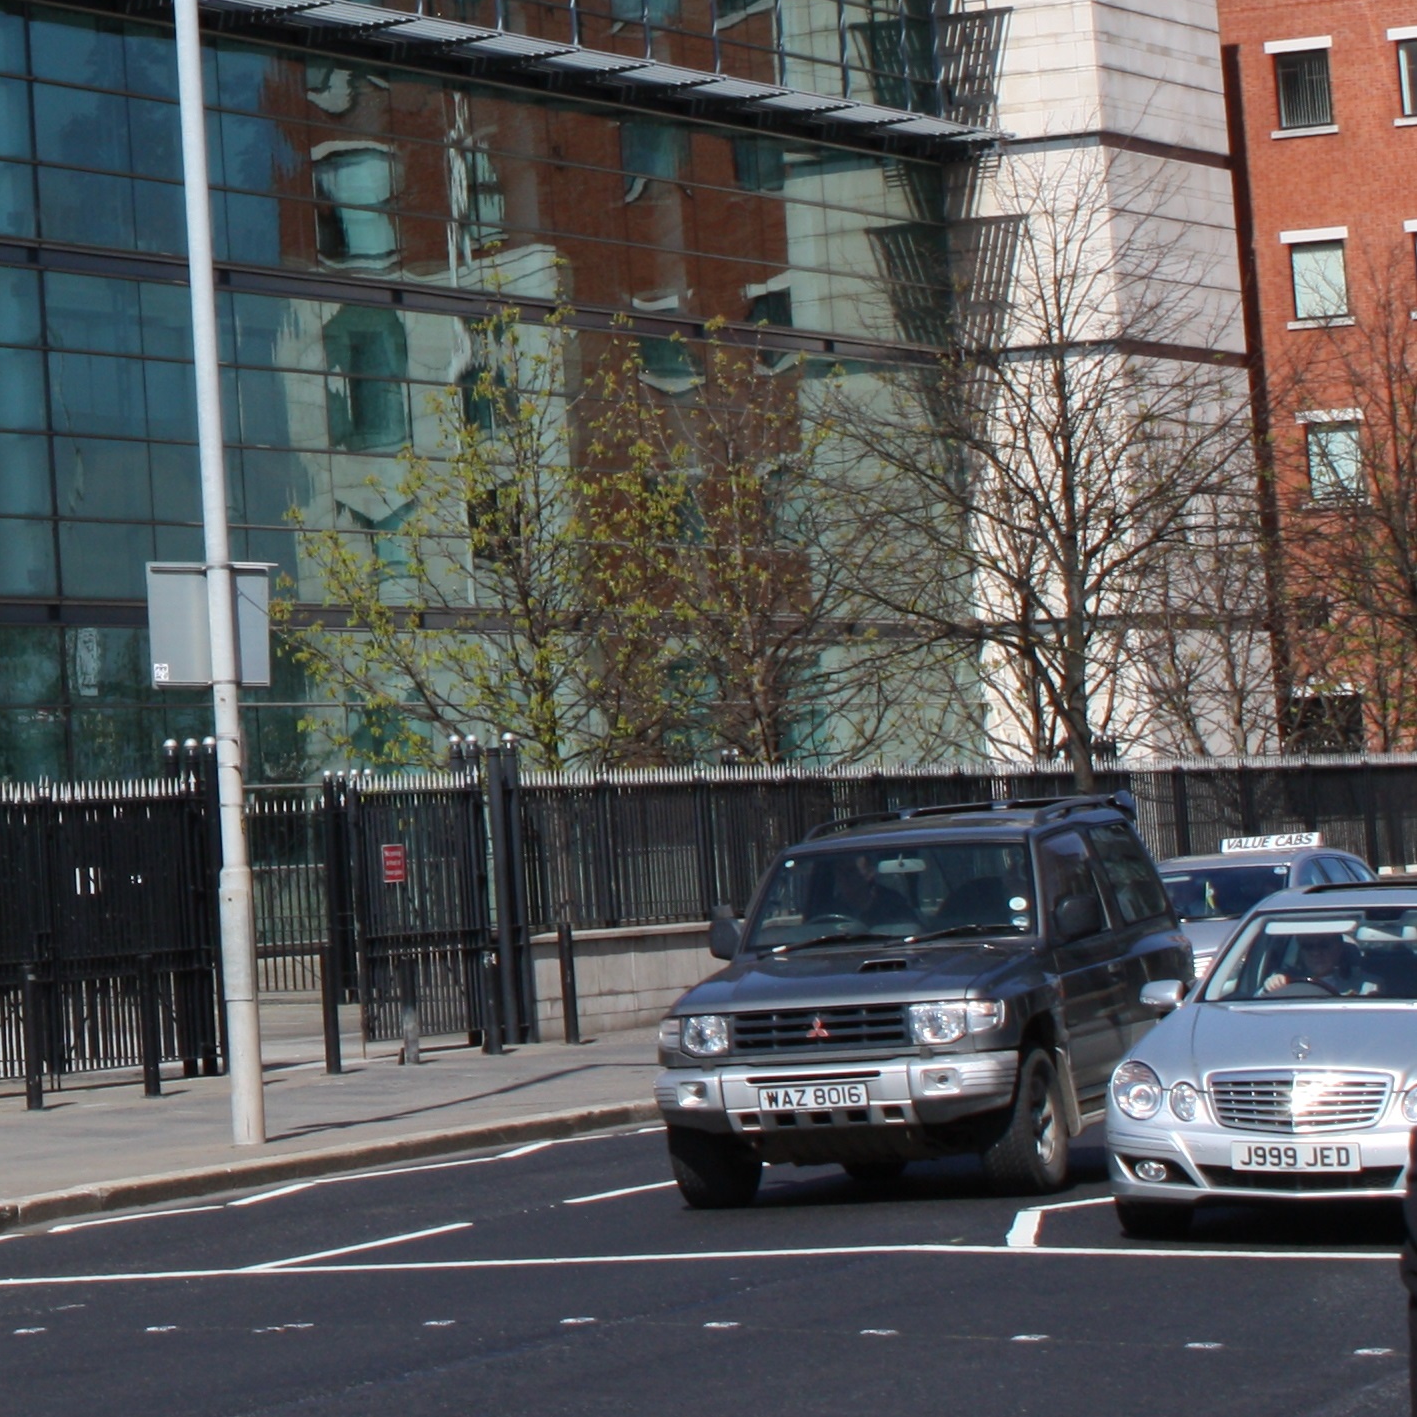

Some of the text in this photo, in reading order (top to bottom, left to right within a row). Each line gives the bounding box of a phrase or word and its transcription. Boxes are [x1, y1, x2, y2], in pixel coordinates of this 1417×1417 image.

[1227, 833, 1314, 850] VALUE CABS
[766, 1086, 862, 1109] WAZ 8016
[1240, 1146, 1351, 1167] J999 JED
